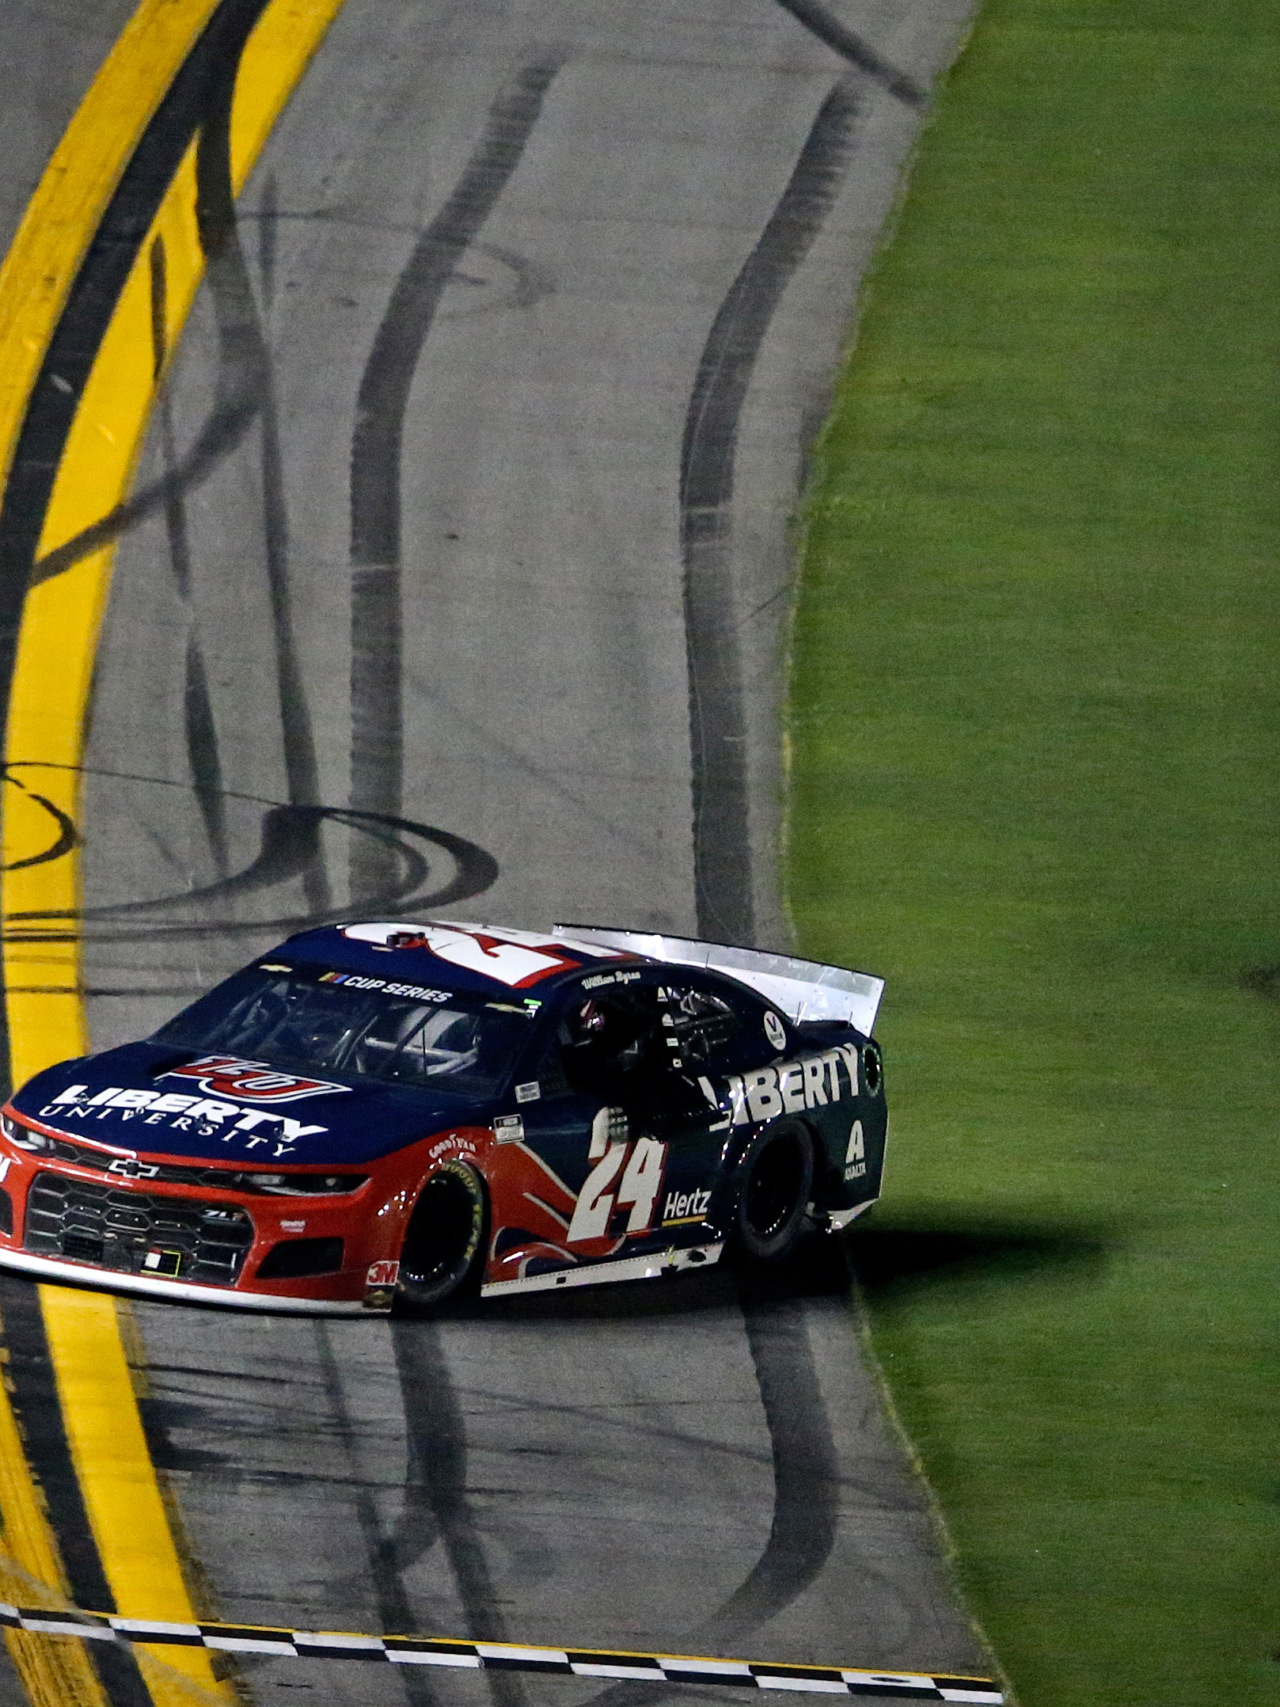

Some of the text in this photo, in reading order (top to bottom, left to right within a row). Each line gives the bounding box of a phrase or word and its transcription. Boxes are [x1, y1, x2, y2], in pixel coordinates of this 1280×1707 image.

[343, 975, 454, 1003] CUP SERIES
[698, 1043, 859, 1132] LIBERTY
[39, 1105, 297, 1157] UNIVERSITY
[51, 1085, 329, 1143] LIBERTY
[566, 1106, 666, 1243] 24
[663, 1187, 712, 1219] Hertz
[368, 1263, 399, 1284] 3M
